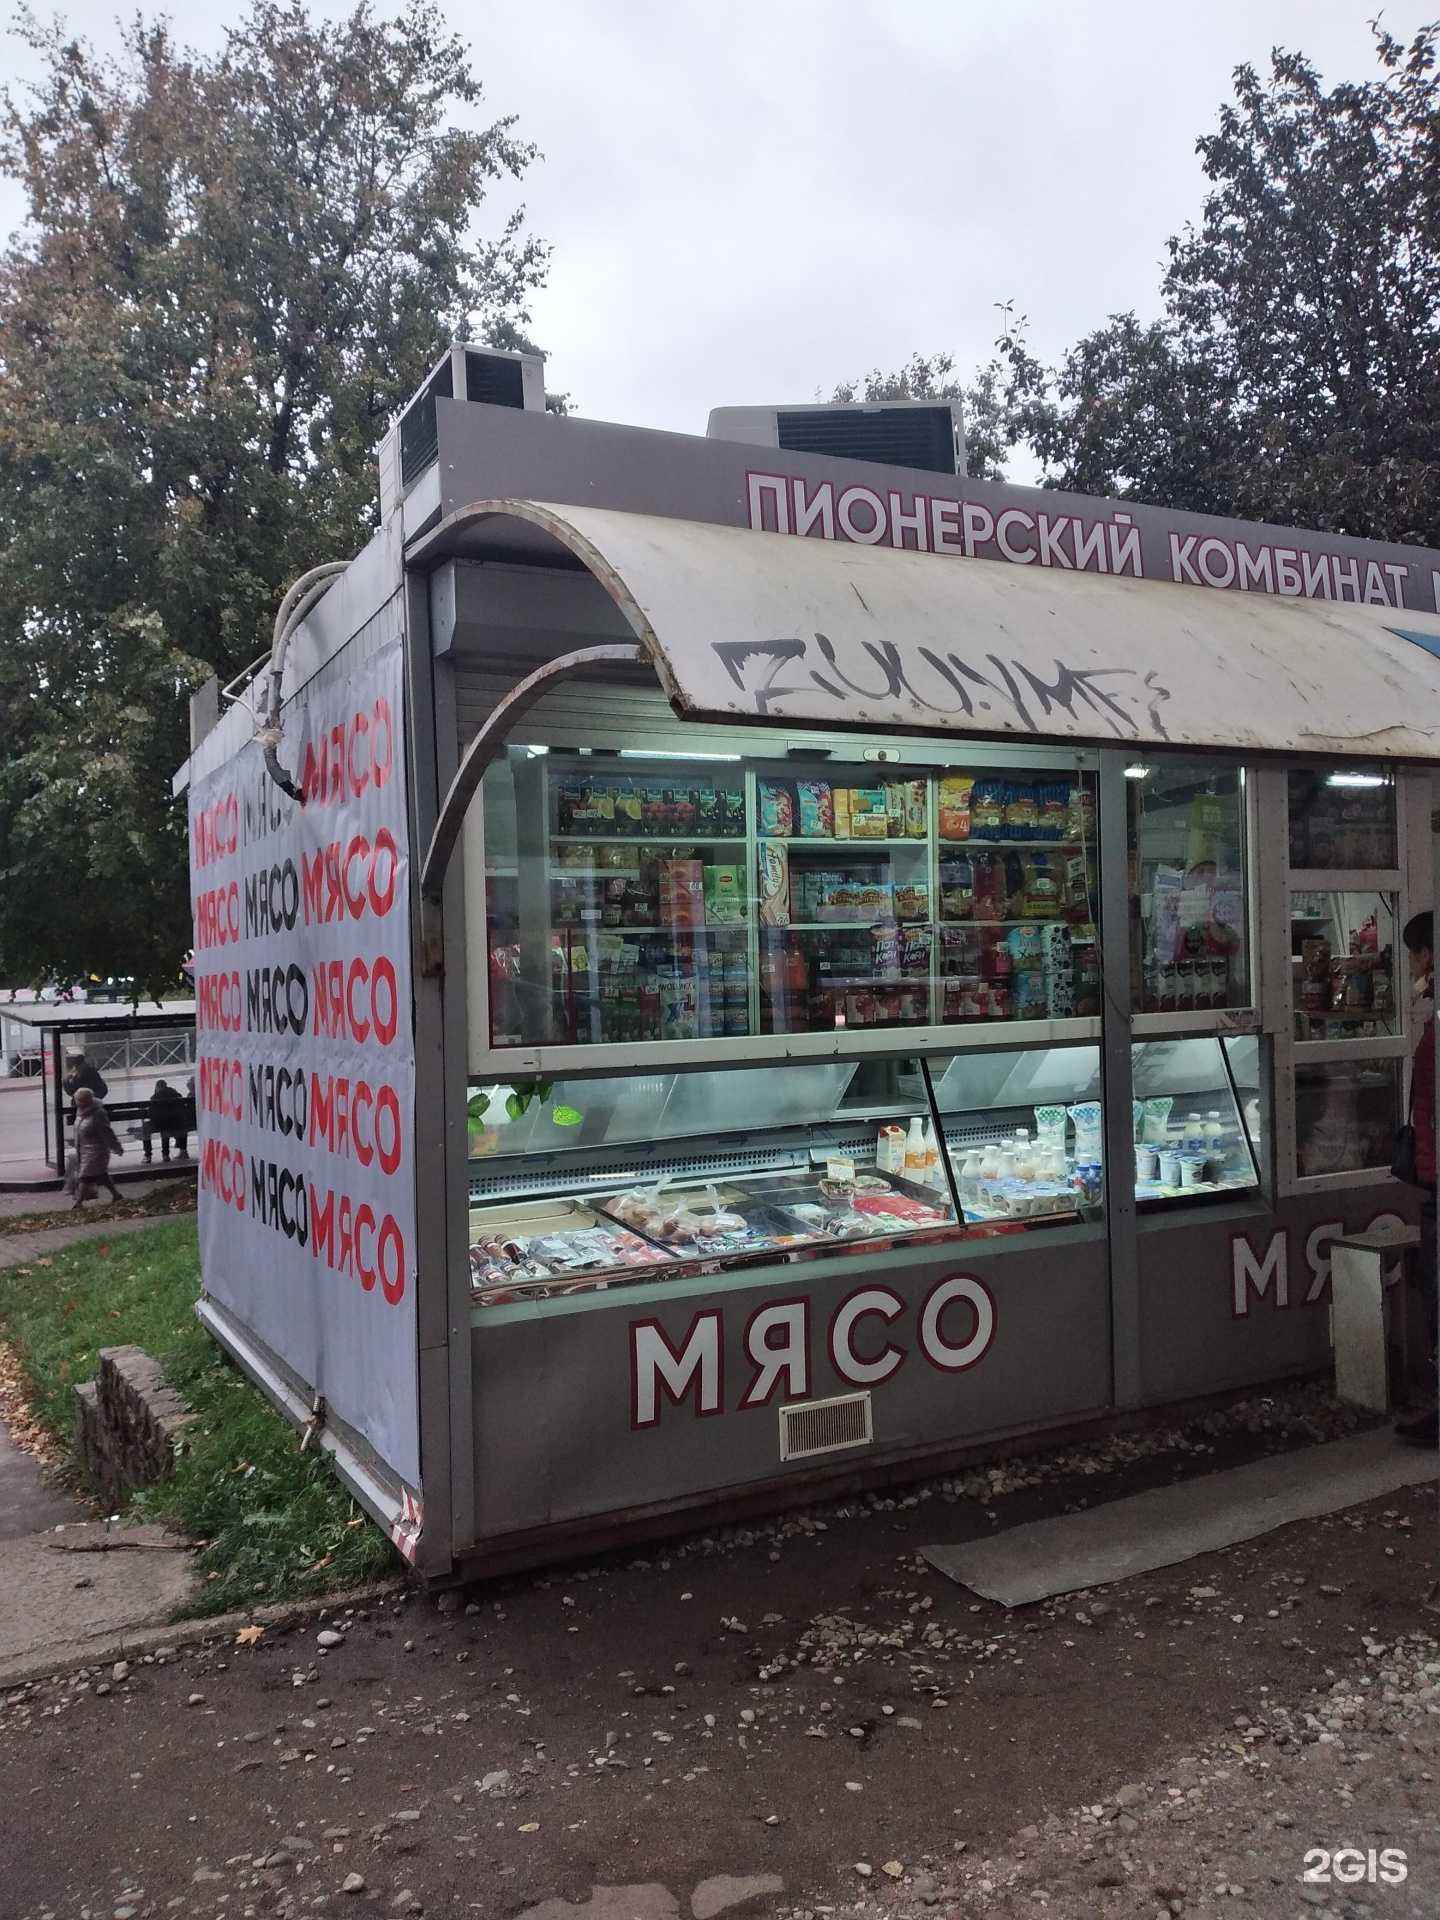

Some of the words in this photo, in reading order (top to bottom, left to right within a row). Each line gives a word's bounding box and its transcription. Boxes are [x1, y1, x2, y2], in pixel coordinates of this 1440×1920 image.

[746, 471, 1143, 578] ПИОНЕРСКИЙ
[1168, 531, 1409, 609] КОМБИНАТ
[301, 695, 394, 806] МЯСО
[195, 880, 241, 950] МЯСО
[244, 857, 300, 940] МЯСО
[301, 827, 398, 927] МЯСО
[198, 969, 241, 1033] МЯСО
[246, 962, 309, 1036] МЯСО
[311, 955, 399, 1046] МЯСО
[199, 1055, 244, 1122] МЯСО
[249, 1062, 307, 1142] МЯСО
[308, 1071, 402, 1175] МЯСО
[201, 1137, 246, 1213] МЯСО
[250, 1155, 309, 1248] МЯСО
[308, 1182, 405, 1307] МЯСО
[631, 1274, 997, 1429] МЯСО
